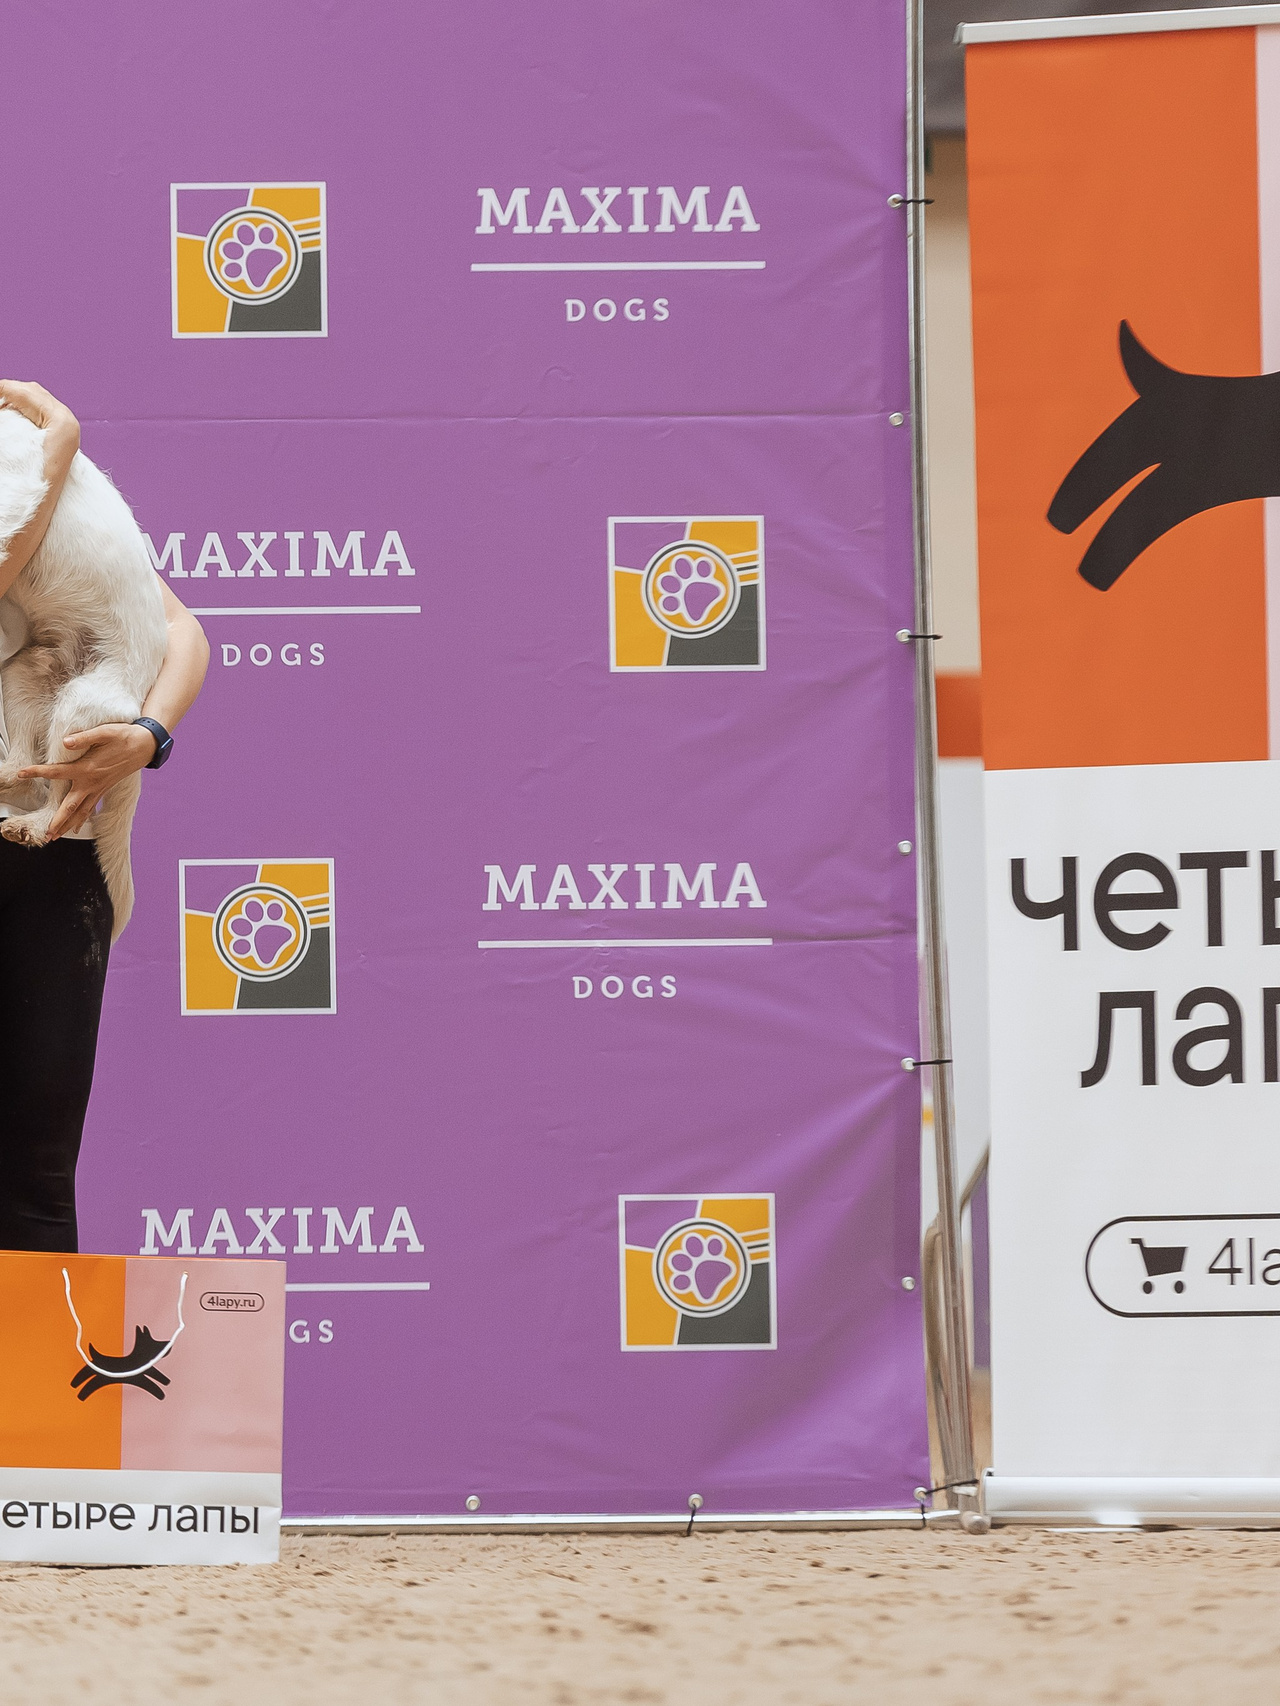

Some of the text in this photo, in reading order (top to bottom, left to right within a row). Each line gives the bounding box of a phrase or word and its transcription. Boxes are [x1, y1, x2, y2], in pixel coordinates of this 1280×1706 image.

[474, 185, 761, 235] MAXIMA
[564, 297, 670, 322] DOGS
[141, 530, 416, 578] MAXIMA
[221, 643, 325, 667] DOGS
[483, 862, 768, 911] MAXIMA
[1010, 850, 1280, 951] чет
[572, 975, 677, 999] DOGS
[136, 1206, 425, 1261] MAXIMA
[207, 1295, 256, 1309] 4lapy.ru
[288, 1319, 334, 1344] GS
[148, 1504, 259, 1534] лапы
